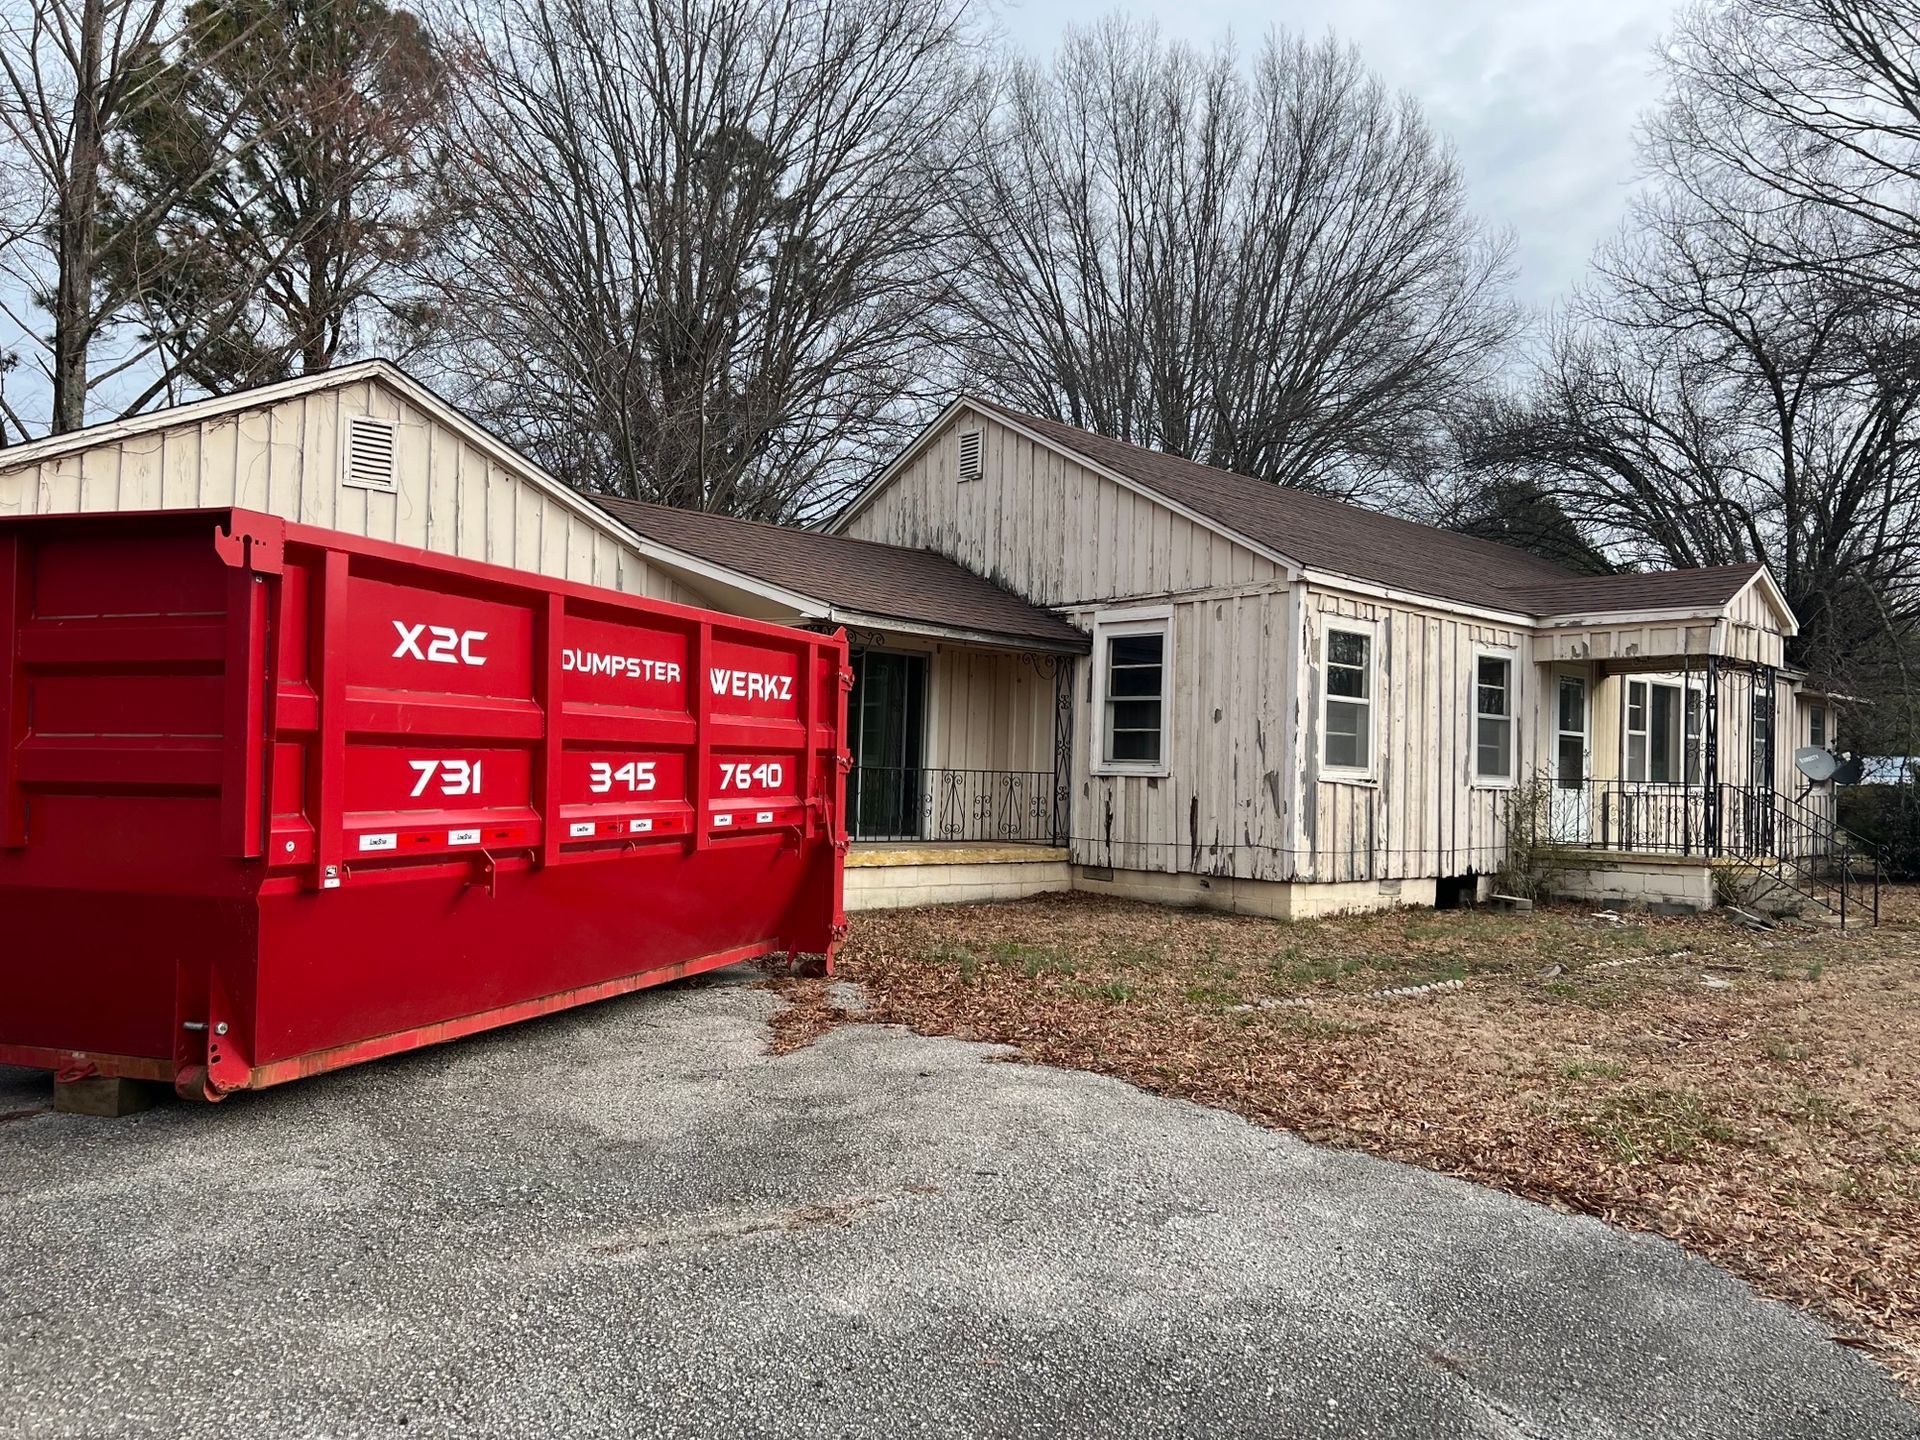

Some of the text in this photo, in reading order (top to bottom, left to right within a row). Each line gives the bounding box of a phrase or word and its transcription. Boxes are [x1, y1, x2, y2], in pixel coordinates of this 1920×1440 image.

[391, 620, 793, 702] X2C DUMPSTER WERKZ
[408, 759, 783, 798] 731 345 7640
